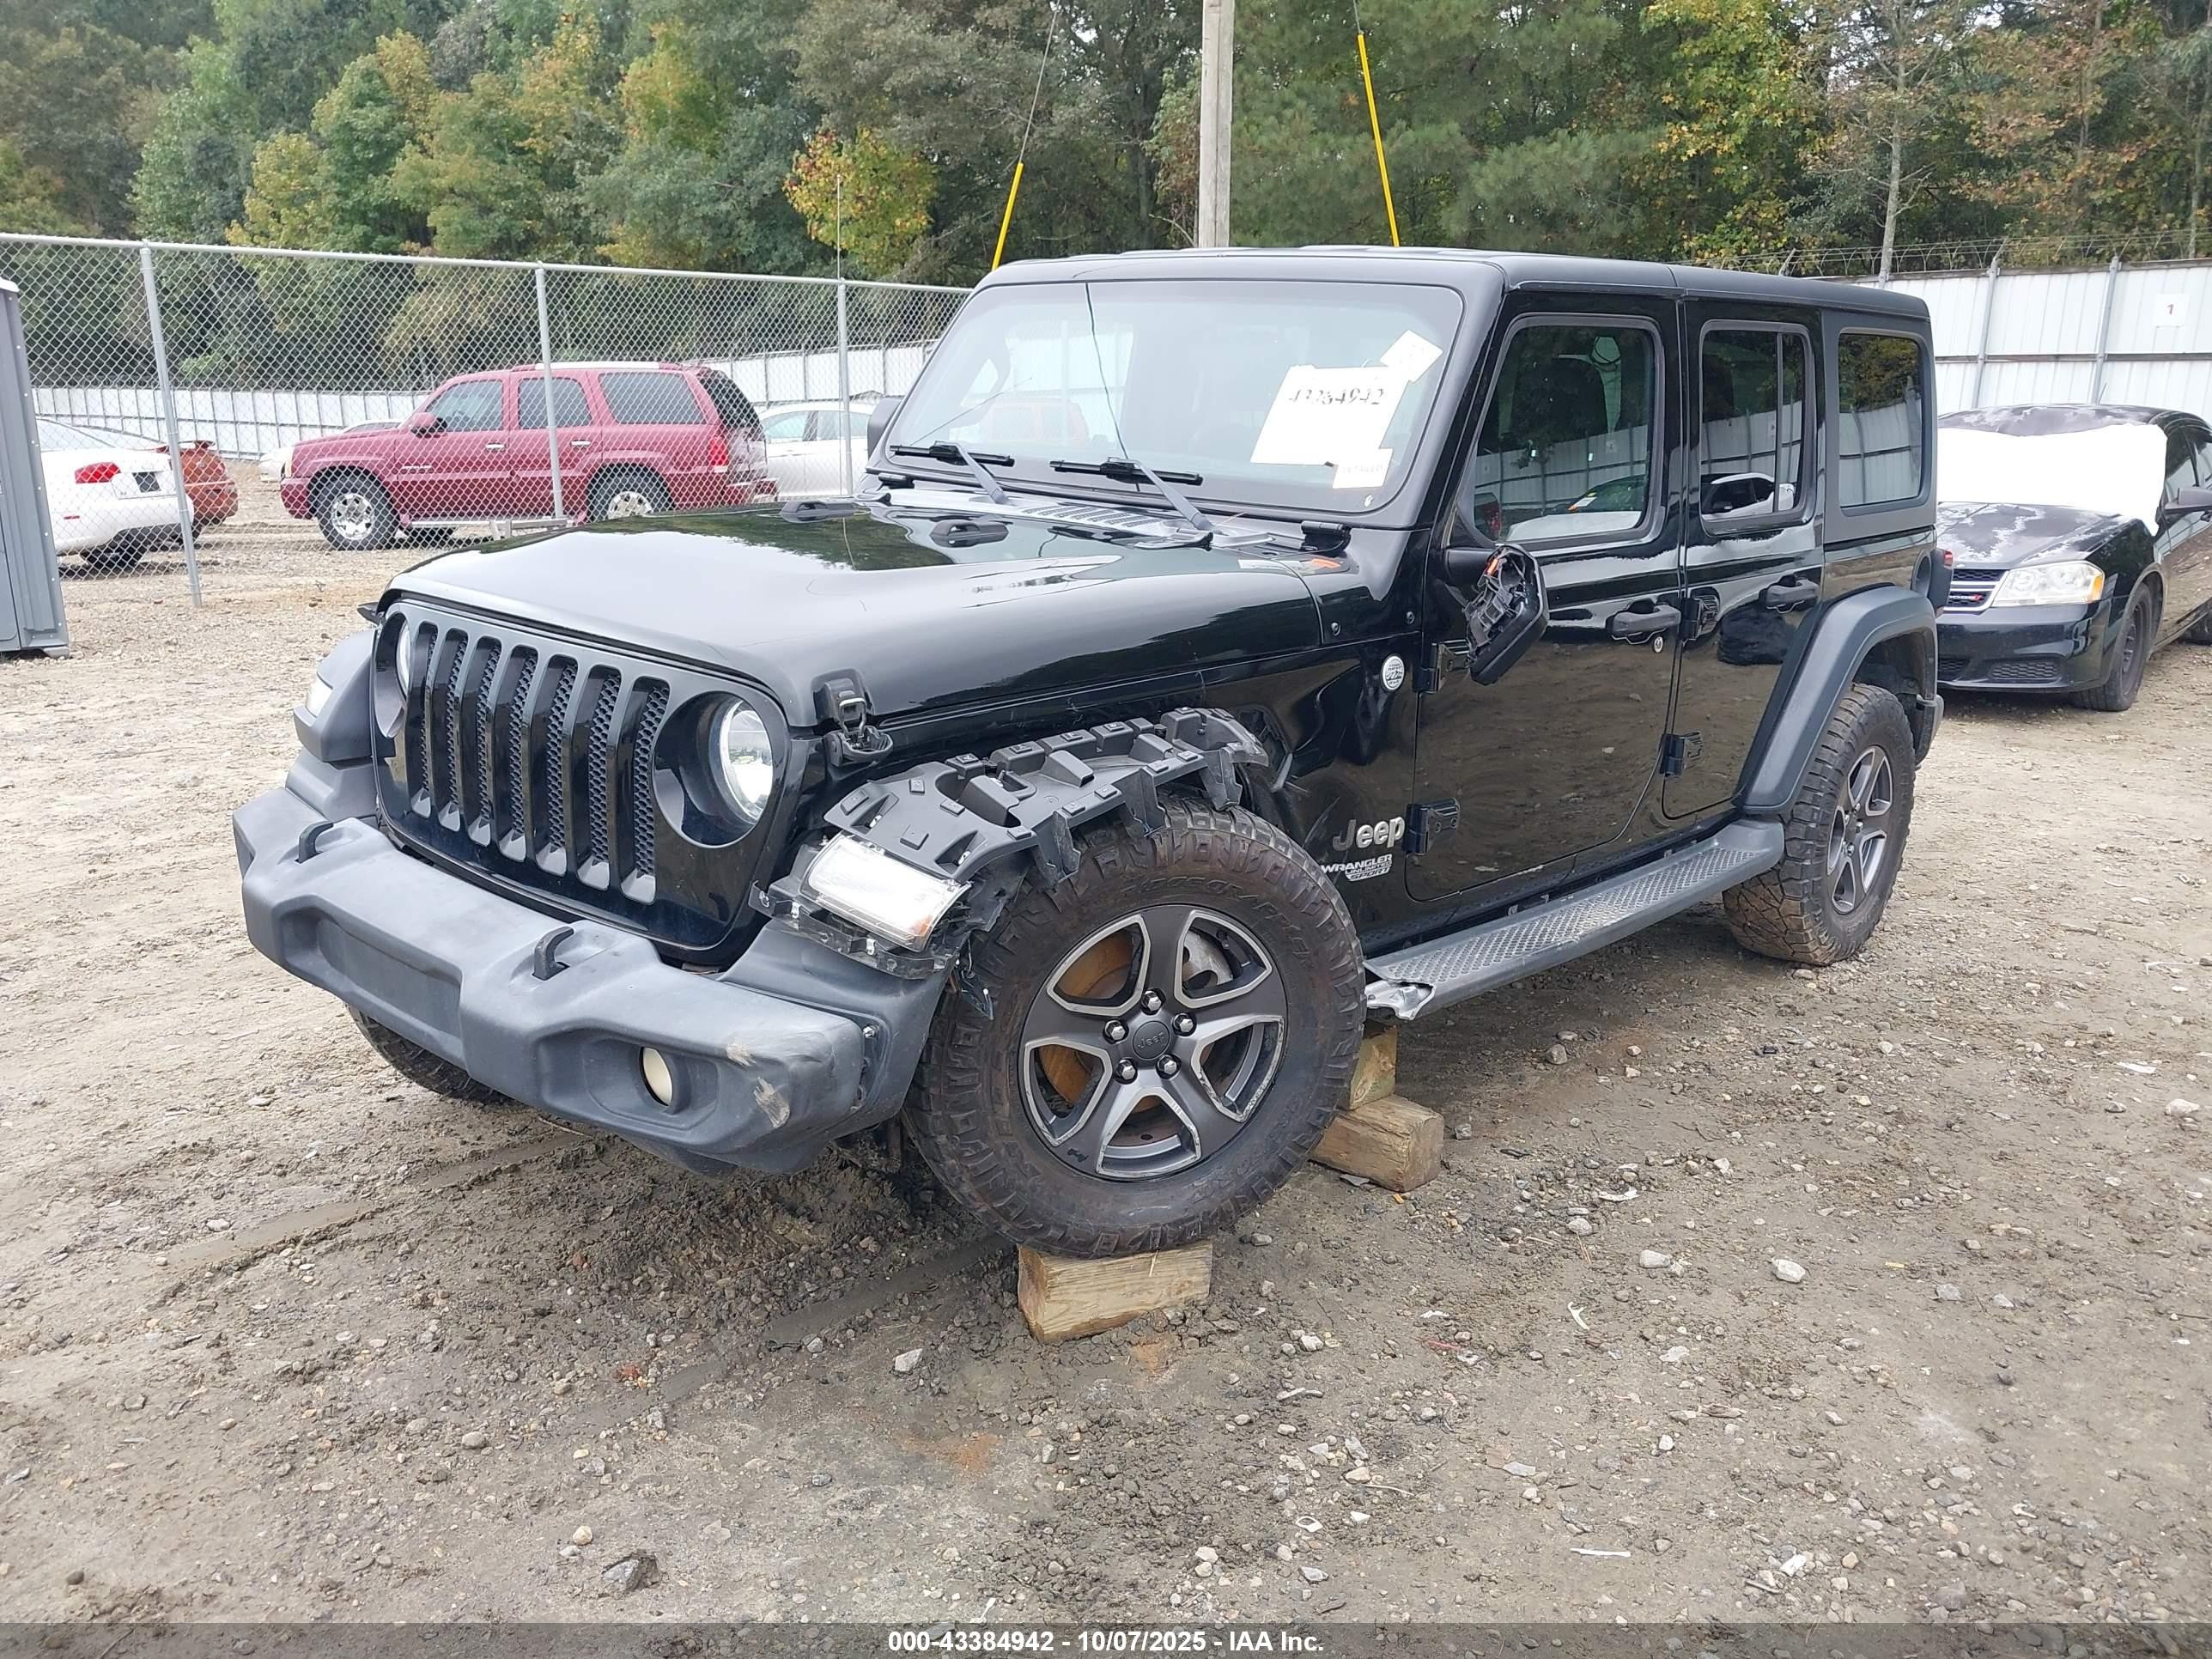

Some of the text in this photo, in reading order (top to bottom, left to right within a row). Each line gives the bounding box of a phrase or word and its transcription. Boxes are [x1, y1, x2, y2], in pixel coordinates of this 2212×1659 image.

[2166, 304, 2174, 315] 1
[1332, 817, 1405, 851] Jeep
[1321, 854, 1393, 873] WRANGLER
